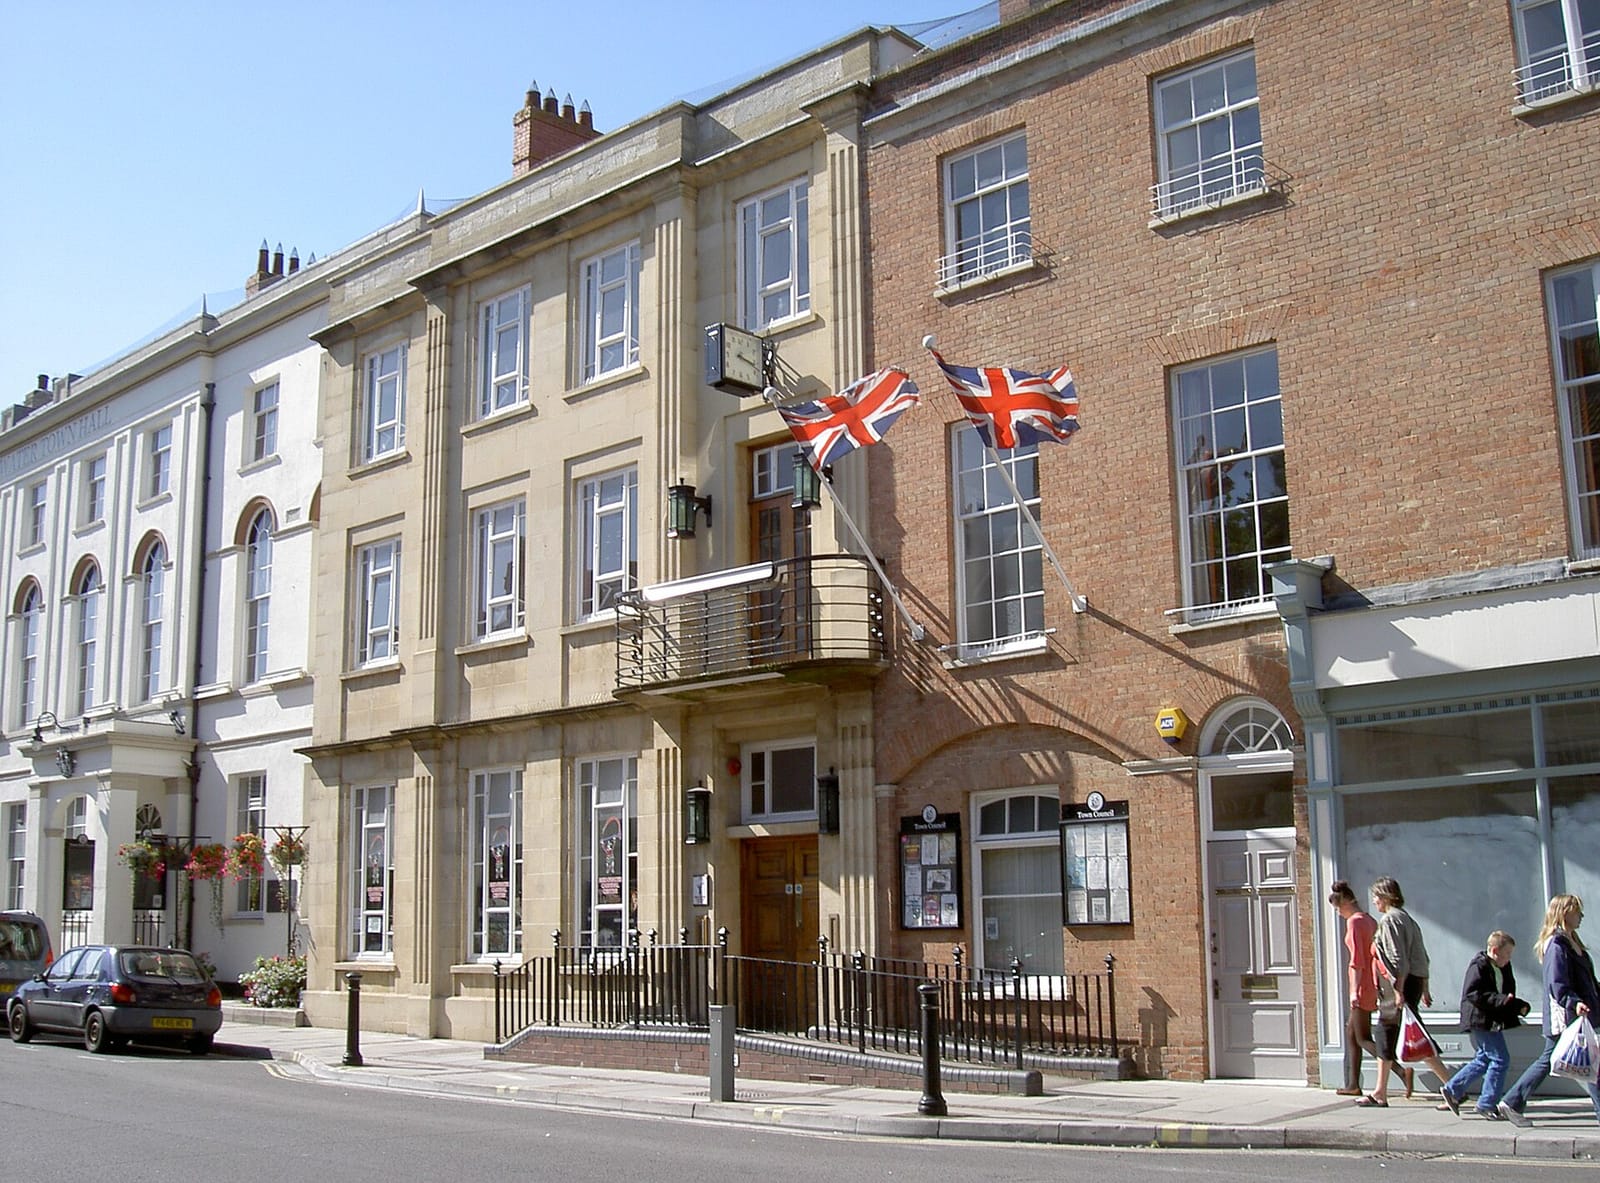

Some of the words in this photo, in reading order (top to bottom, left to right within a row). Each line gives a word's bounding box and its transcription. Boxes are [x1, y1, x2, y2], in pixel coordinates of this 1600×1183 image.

[41, 421, 77, 455] TOWN
[79, 405, 112, 440] HALL
[1077, 811, 1093, 819] Town
[1093, 808, 1115, 818] Council
[928, 821, 946, 830] Council
[1558, 1061, 1591, 1077] TESCO
